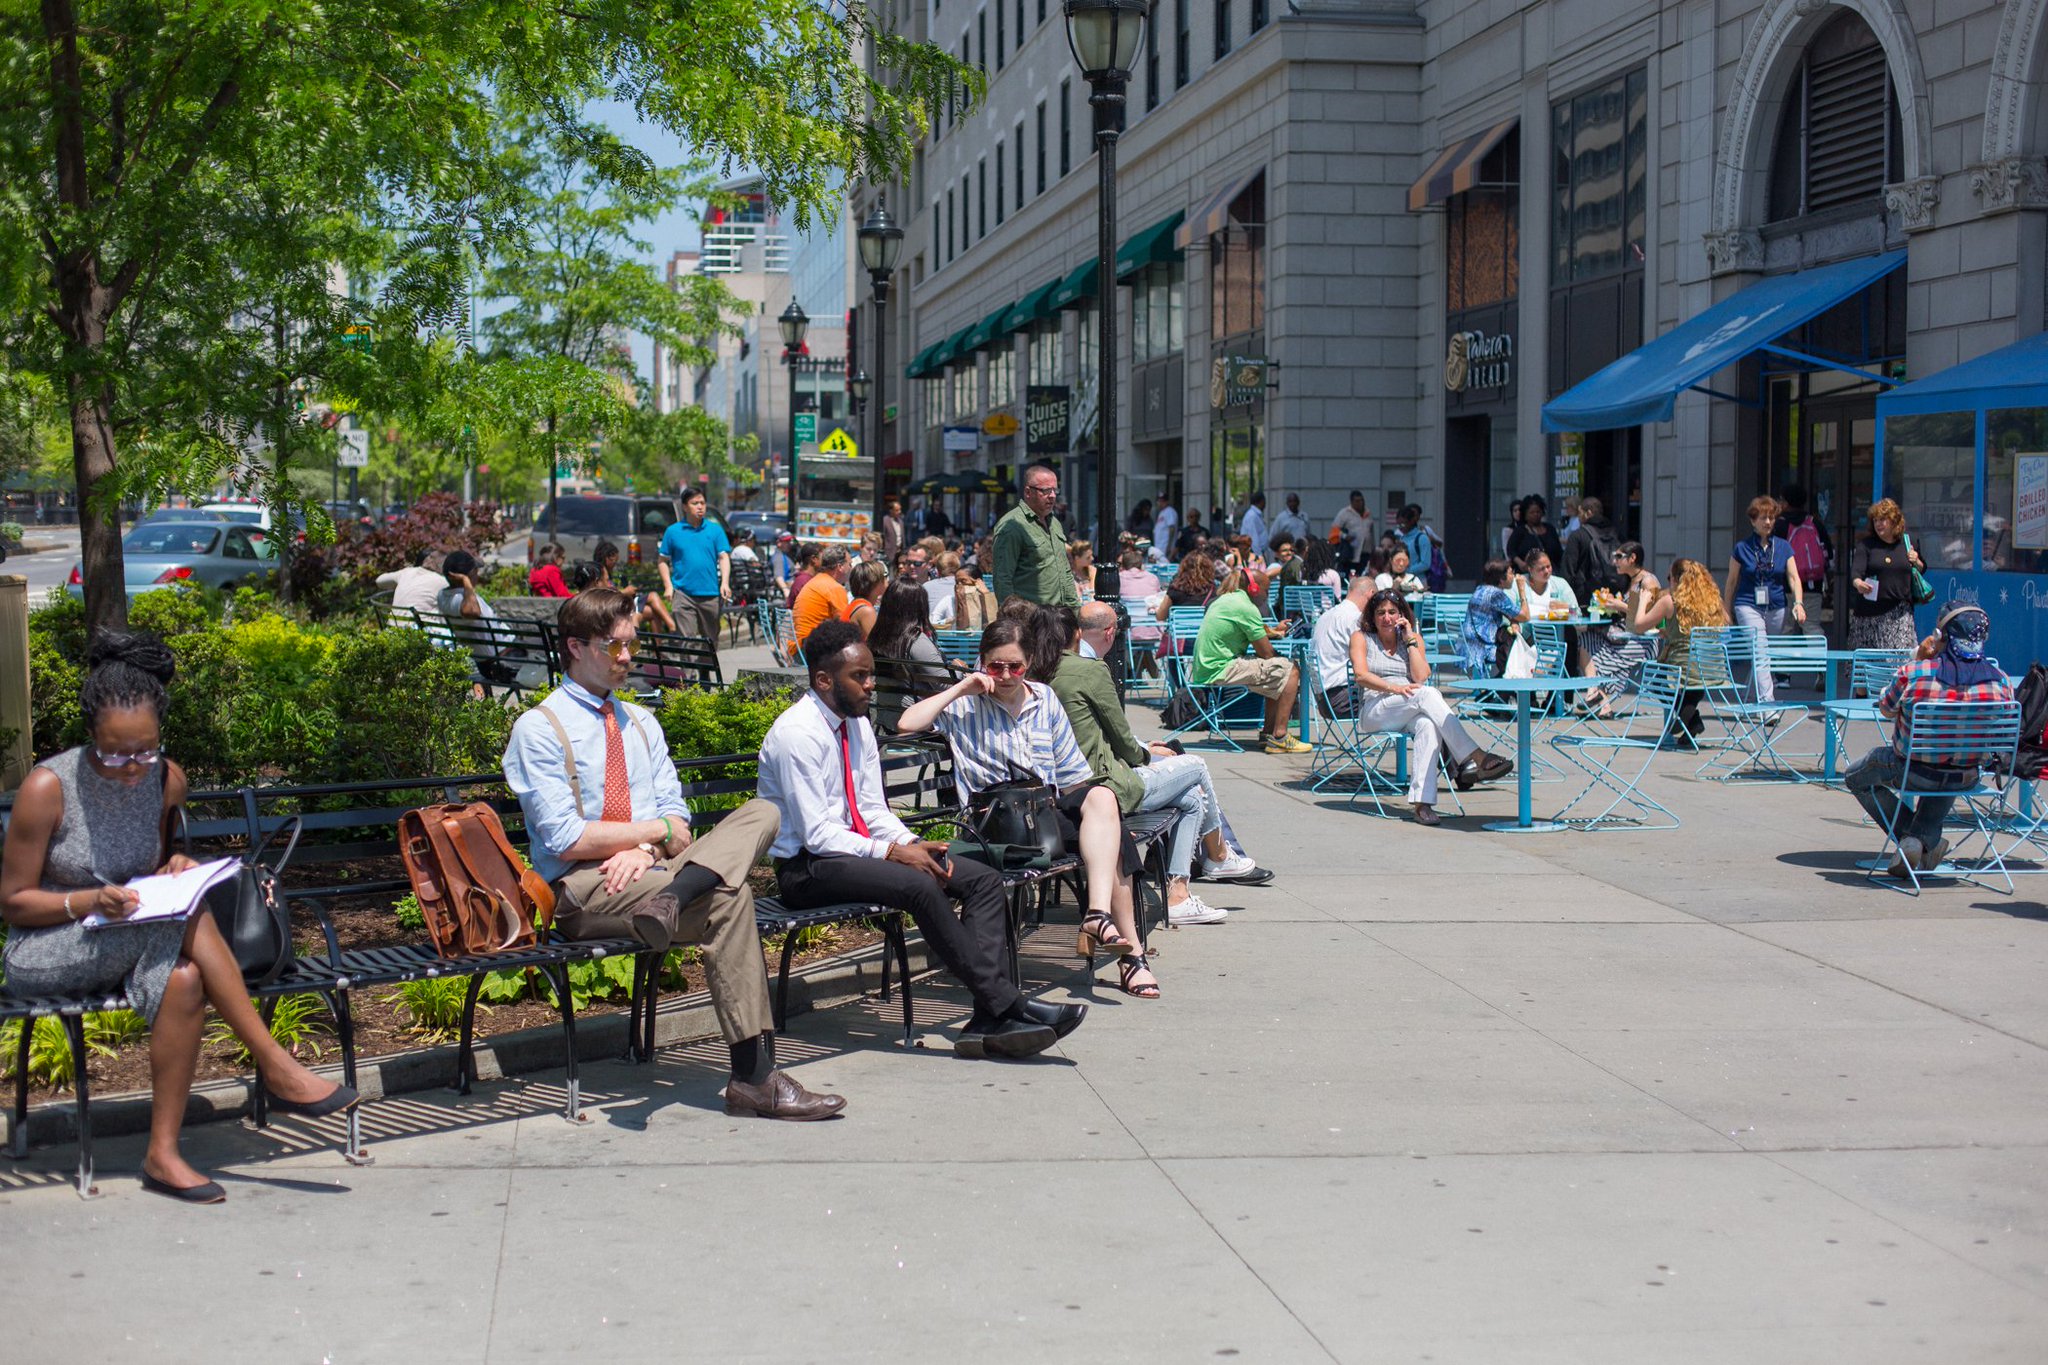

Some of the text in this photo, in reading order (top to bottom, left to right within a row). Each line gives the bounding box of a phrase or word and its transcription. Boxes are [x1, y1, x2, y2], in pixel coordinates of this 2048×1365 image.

[1027, 400, 1068, 423] JUICE
[352, 433, 364, 442] NO
[1029, 416, 1066, 443] SHOP
[1555, 454, 1579, 468] HAPPY
[1555, 469, 1579, 485] HOUR
[2020, 488, 2046, 508] GRILLED
[2018, 504, 2046, 524] CHICKEN
